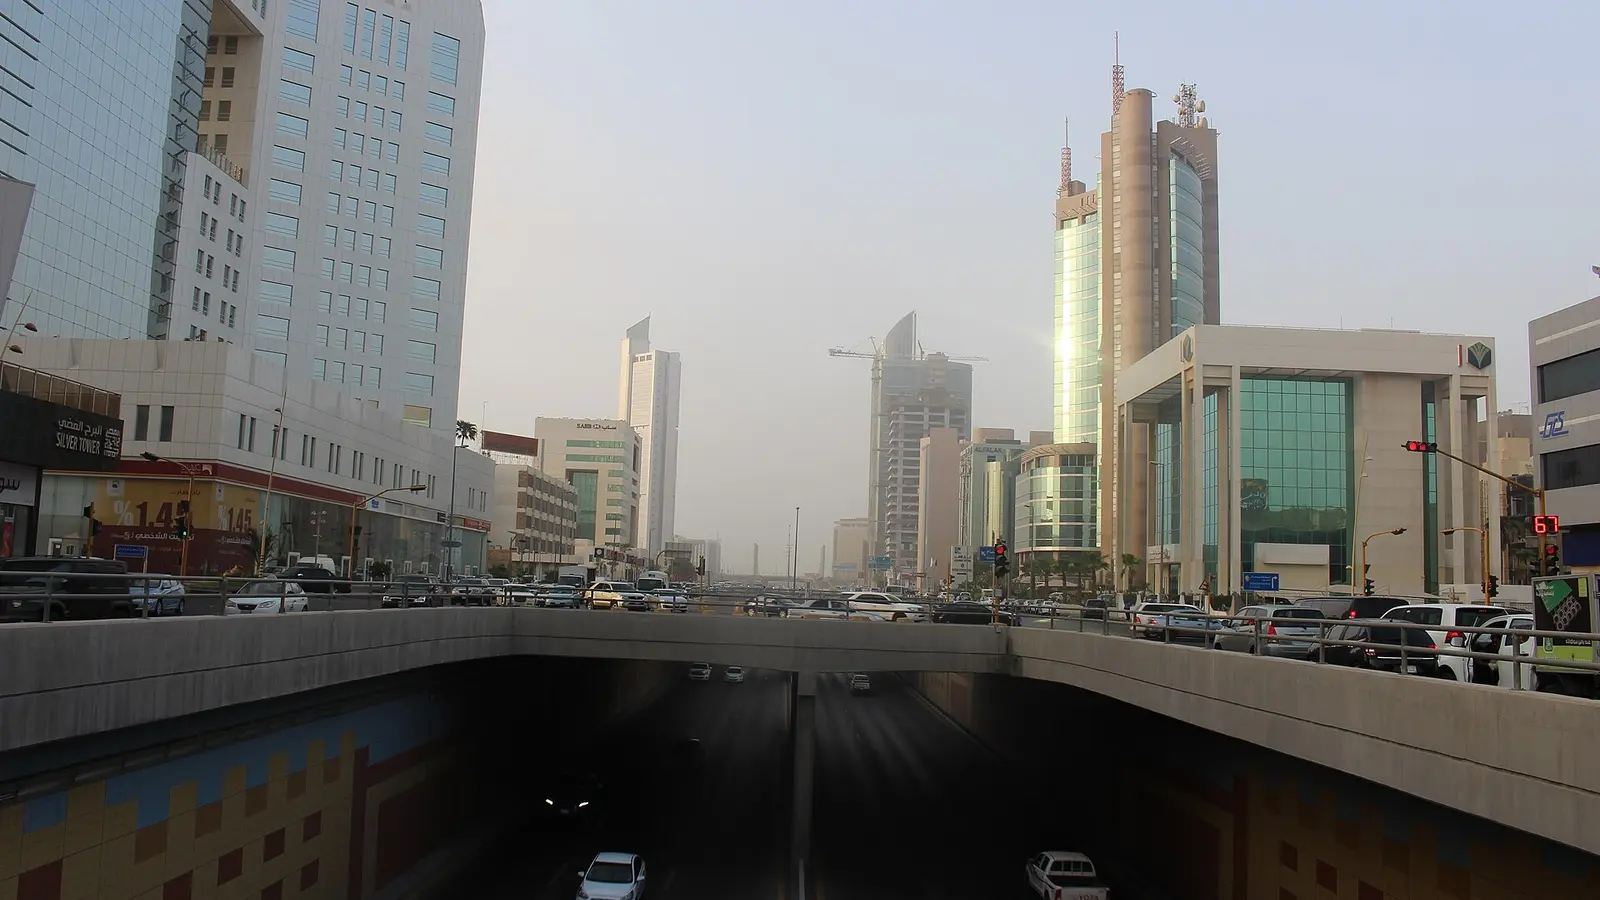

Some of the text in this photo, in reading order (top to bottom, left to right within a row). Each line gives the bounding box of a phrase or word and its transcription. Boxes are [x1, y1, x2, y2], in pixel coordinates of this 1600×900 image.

[58, 417, 103, 437] البرج الفضي
[55, 432, 78, 451] SILVER
[79, 437, 101, 455] TOWER
[1534, 516, 1558, 533] 67
